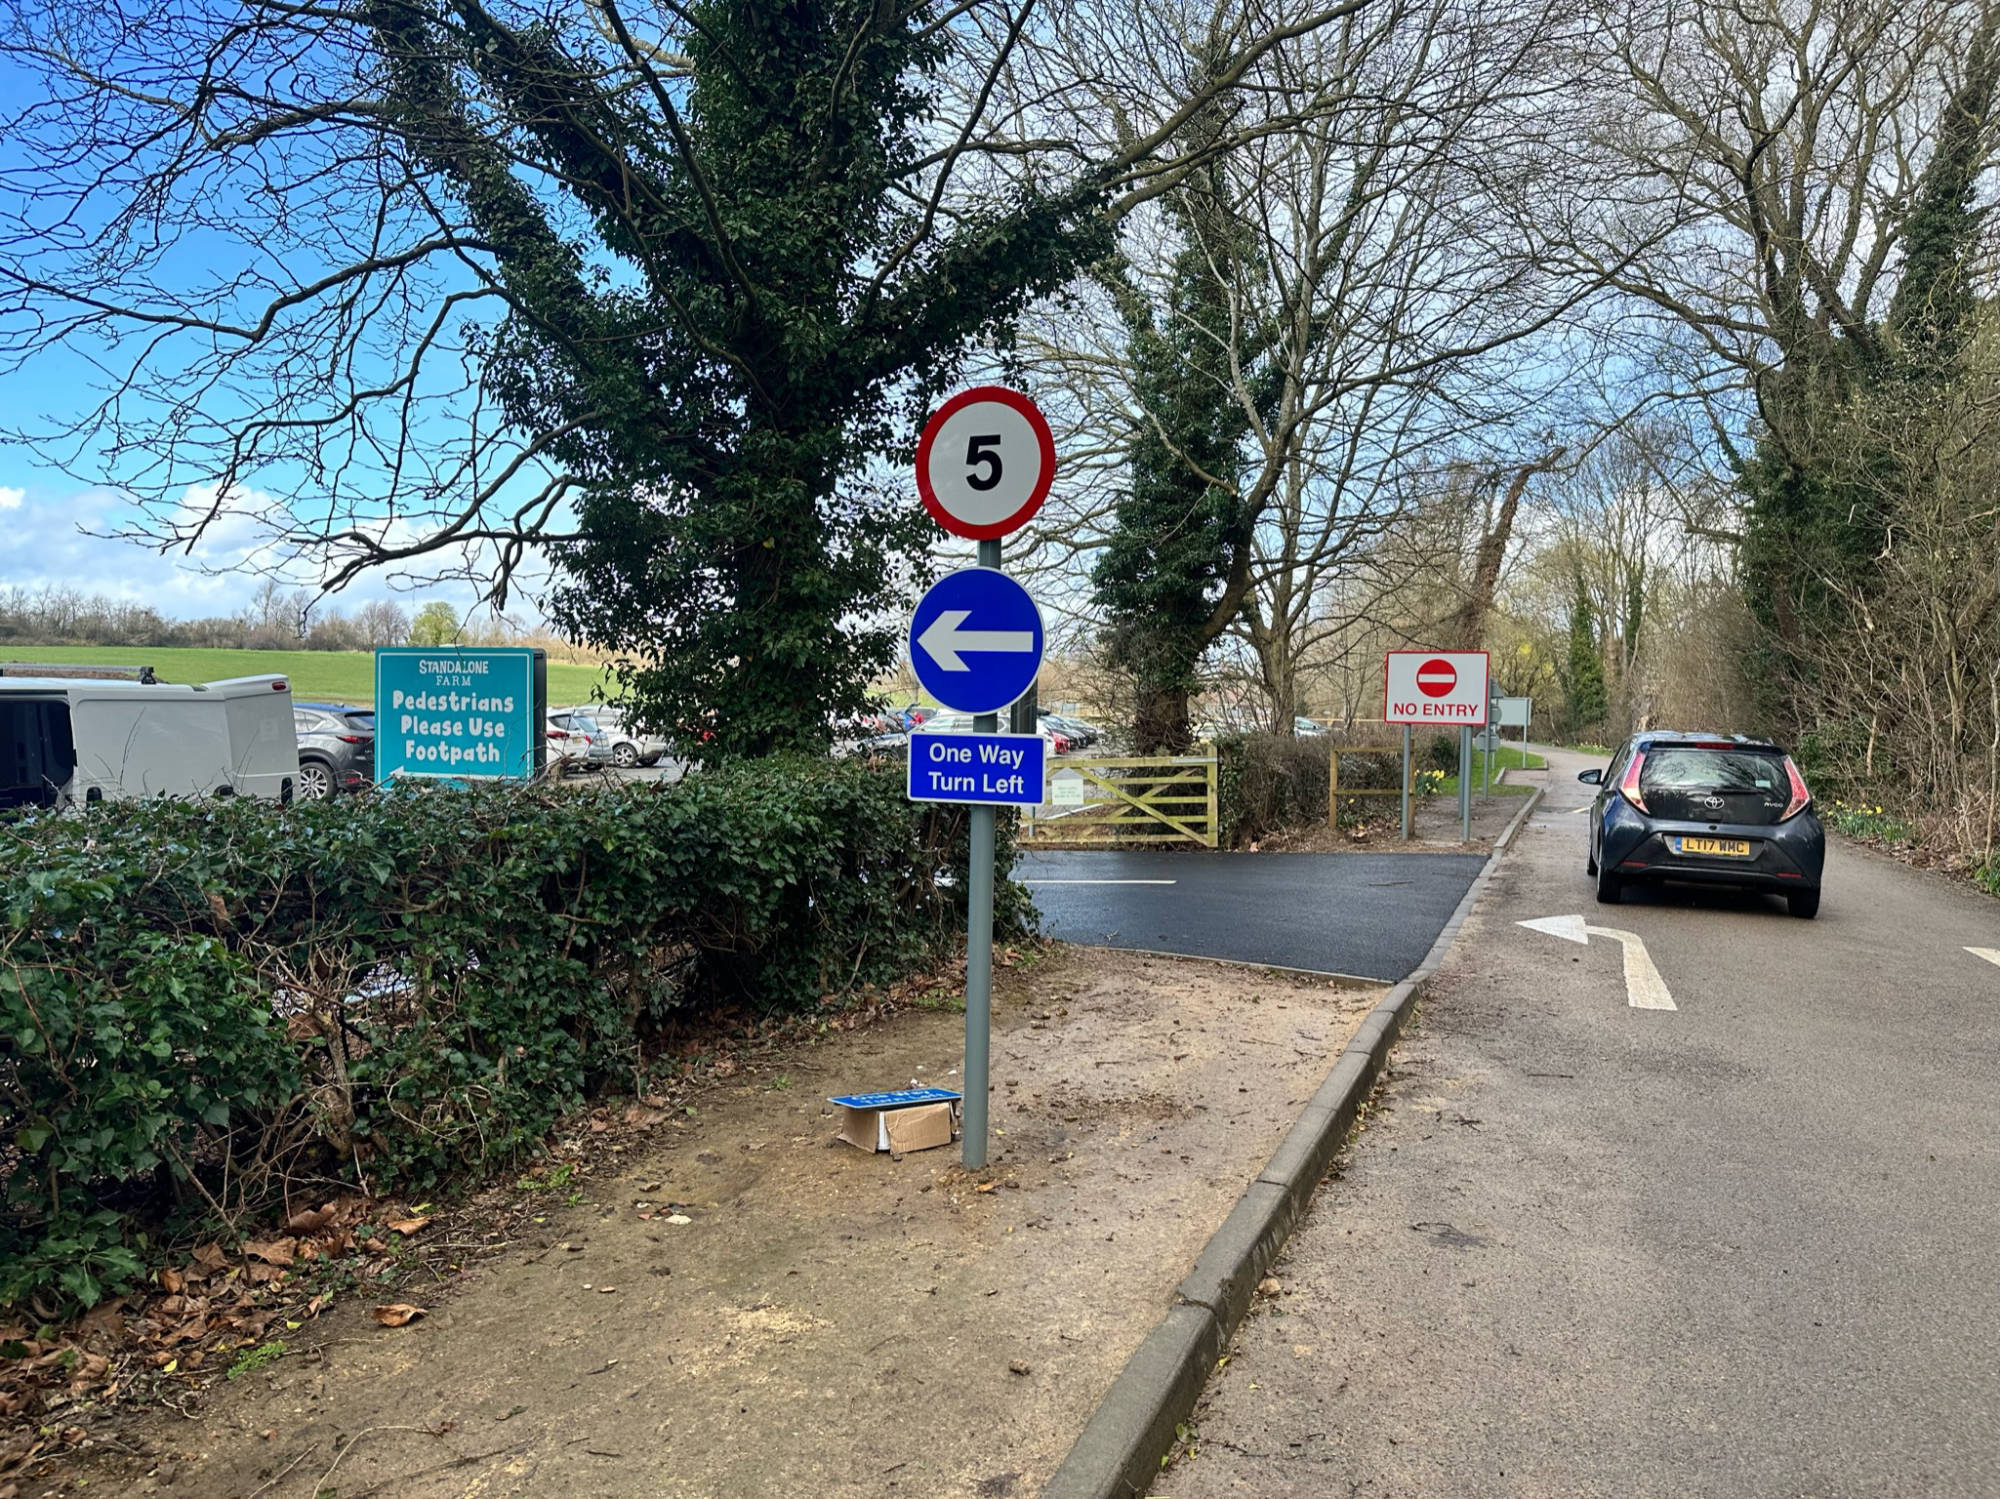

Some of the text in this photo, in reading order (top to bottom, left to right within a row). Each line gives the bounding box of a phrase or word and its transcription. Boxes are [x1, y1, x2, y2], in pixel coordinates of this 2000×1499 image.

[965, 434, 1003, 491] 5
[419, 659, 489, 674] STANDALONE
[436, 675, 471, 686] FARM
[392, 690, 514, 713] Pedestrians
[1393, 703, 1478, 716] NO ENTRY
[401, 715, 505, 738] Please Use
[405, 740, 500, 765] Footpath
[929, 742, 1024, 770] One Way
[928, 771, 1024, 794] Turn Left
[1686, 838, 1716, 851] LT17
